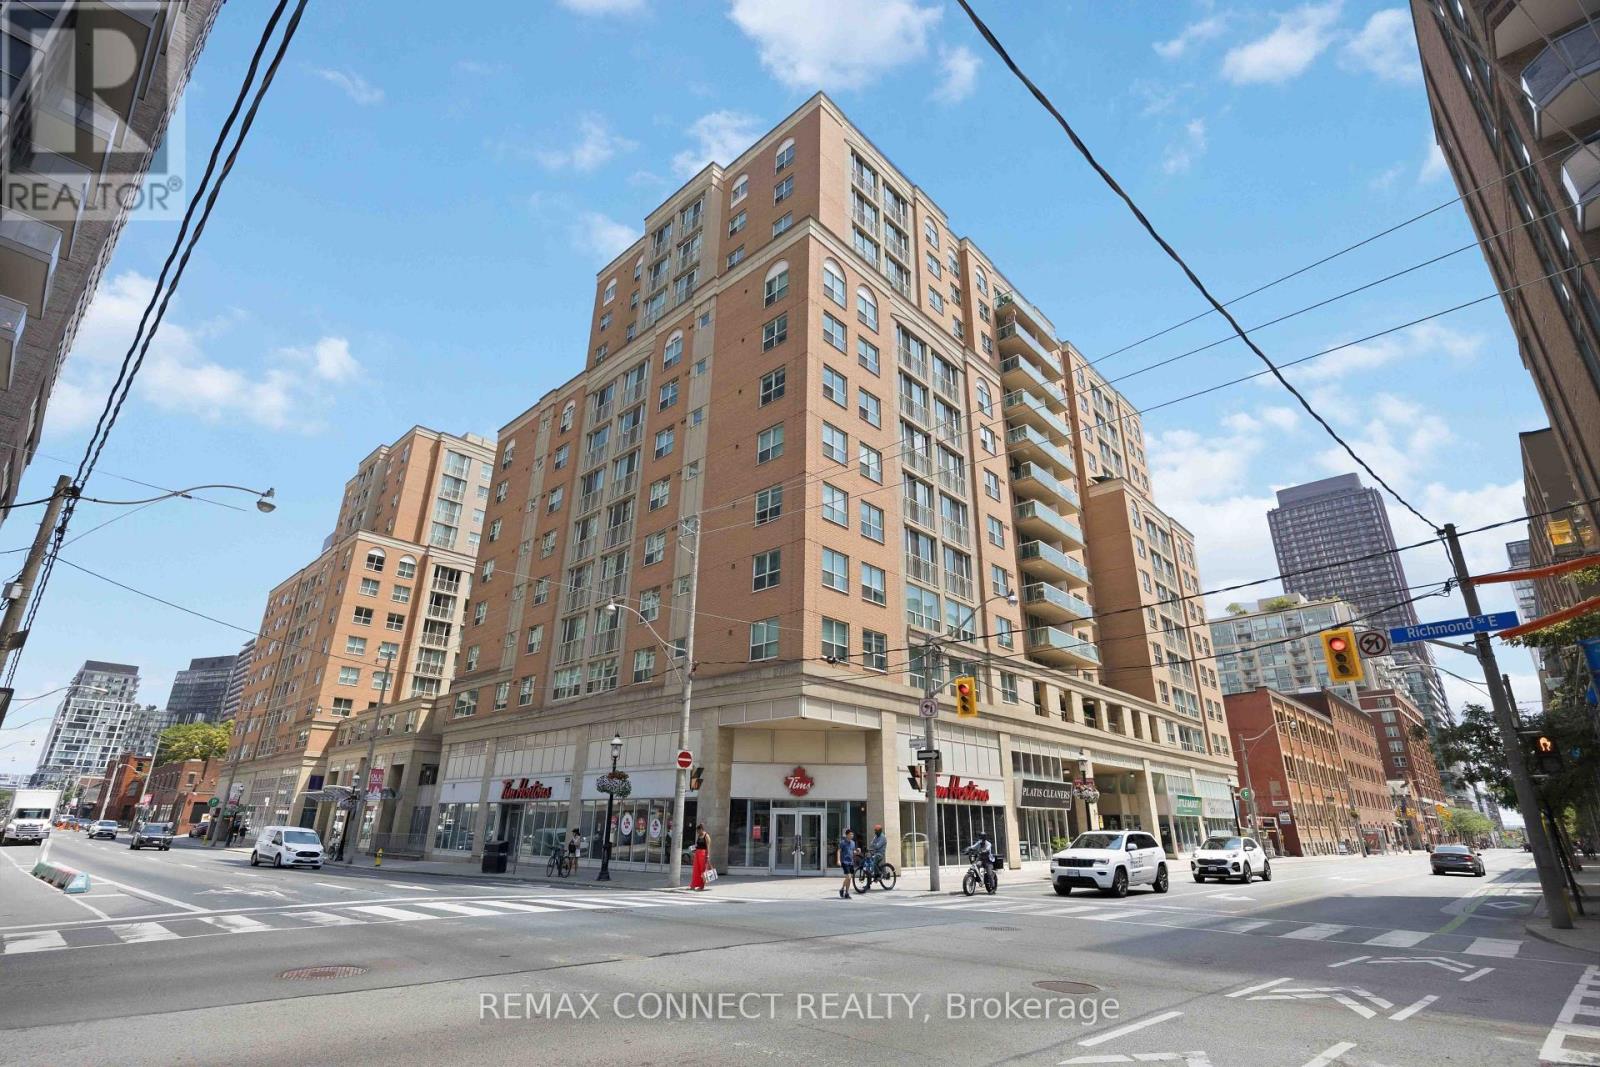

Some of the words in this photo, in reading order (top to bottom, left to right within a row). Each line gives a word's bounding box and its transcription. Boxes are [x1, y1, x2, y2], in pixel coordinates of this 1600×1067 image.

[1407, 619, 1474, 639] Richmond
[1487, 615, 1498, 627] E
[787, 776, 811, 790] Tims
[1043, 789, 1071, 800] CLEANERS
